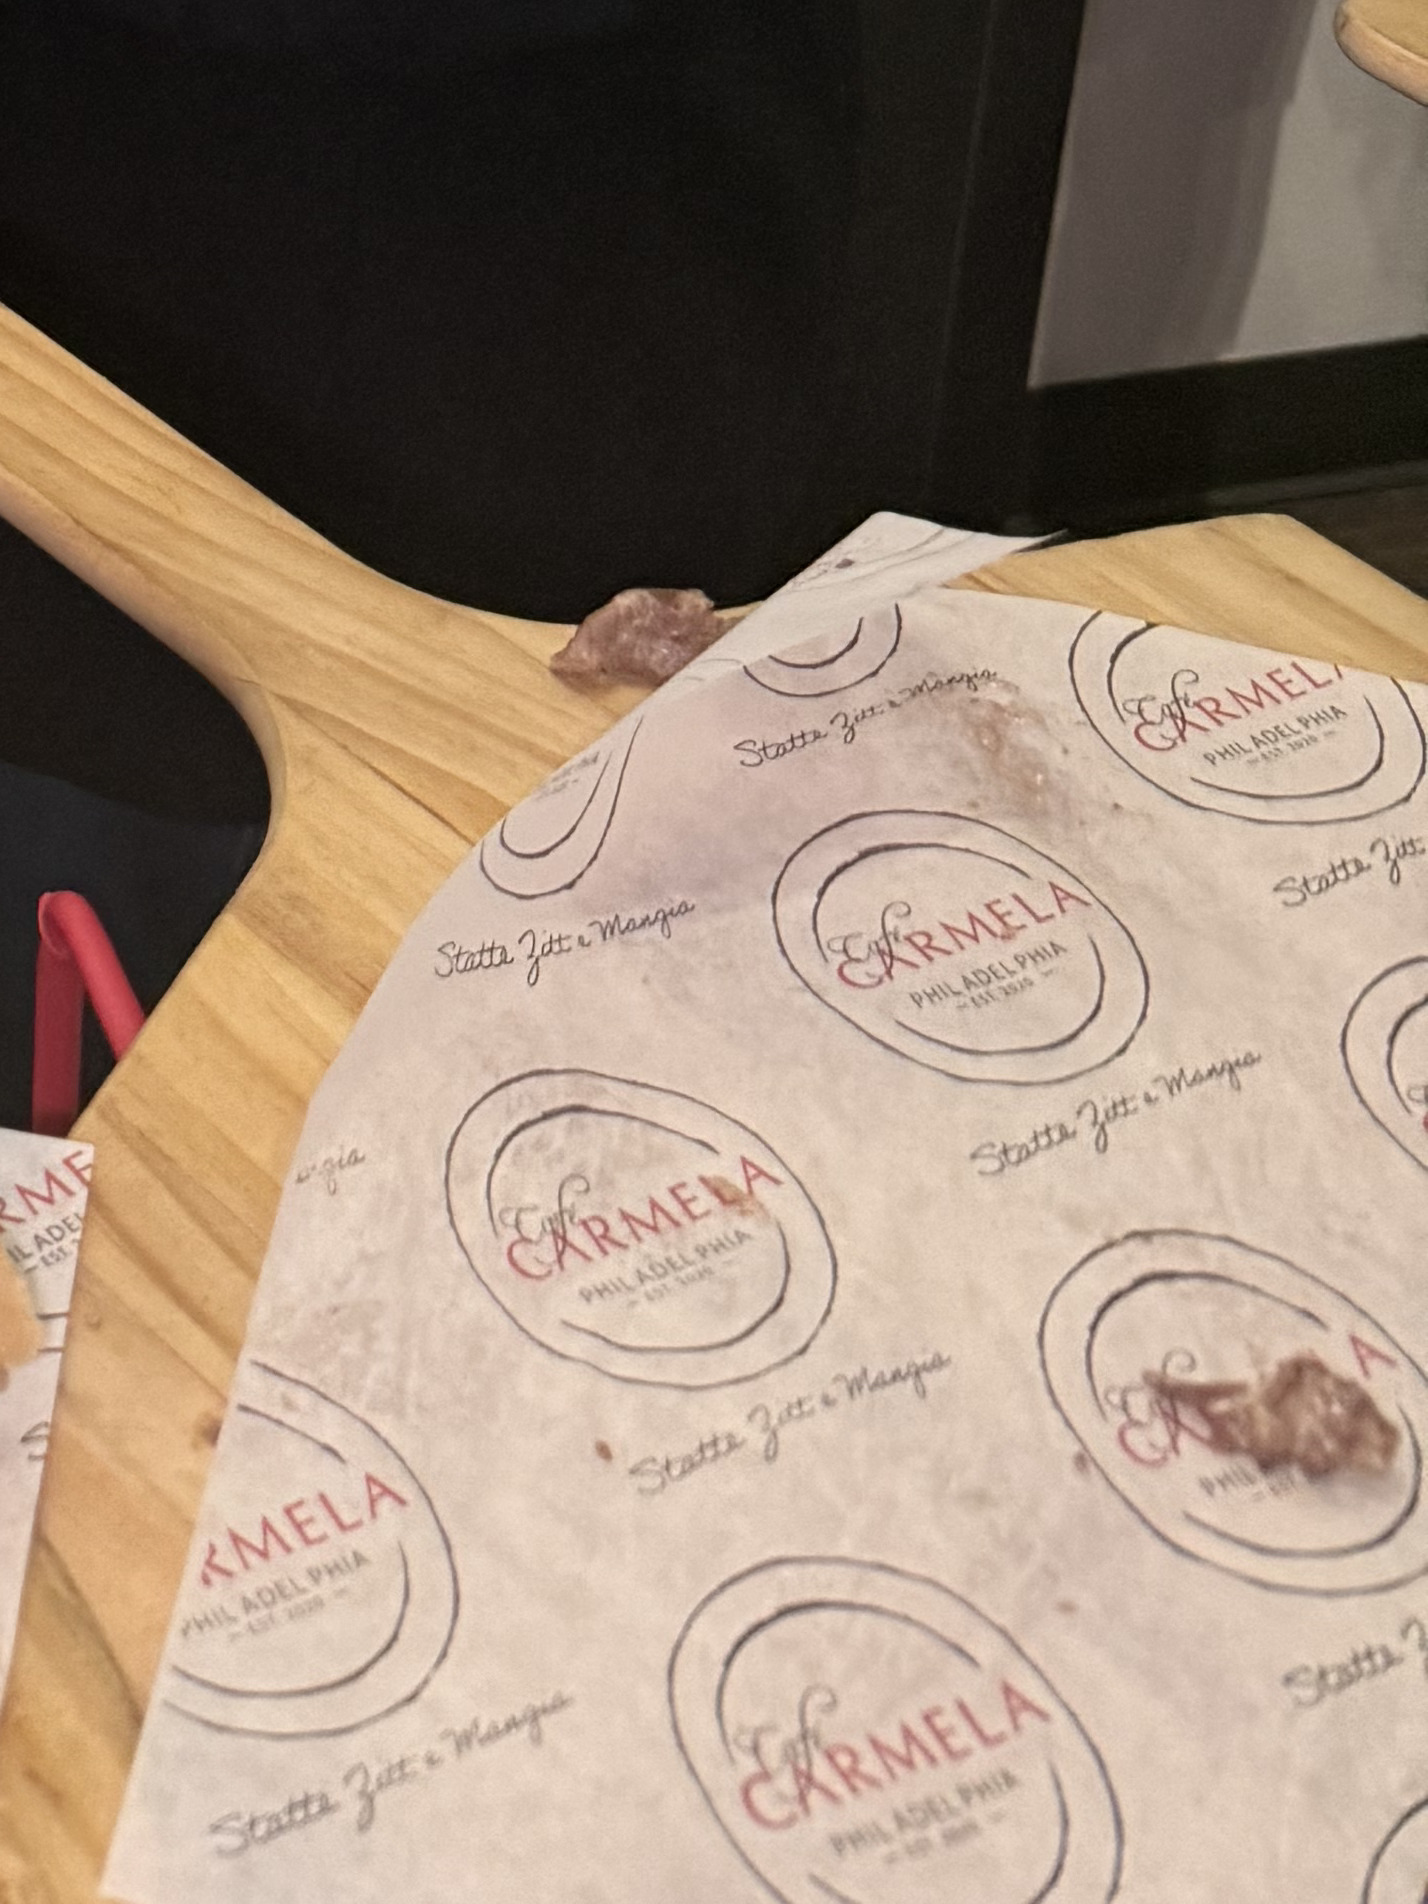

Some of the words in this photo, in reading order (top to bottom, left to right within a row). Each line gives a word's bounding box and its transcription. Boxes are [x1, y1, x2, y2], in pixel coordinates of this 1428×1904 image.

[837, 880, 1093, 991] CARMELA
[506, 1154, 785, 1284] CARMELA
[744, 1679, 1051, 1831] CARMELA
